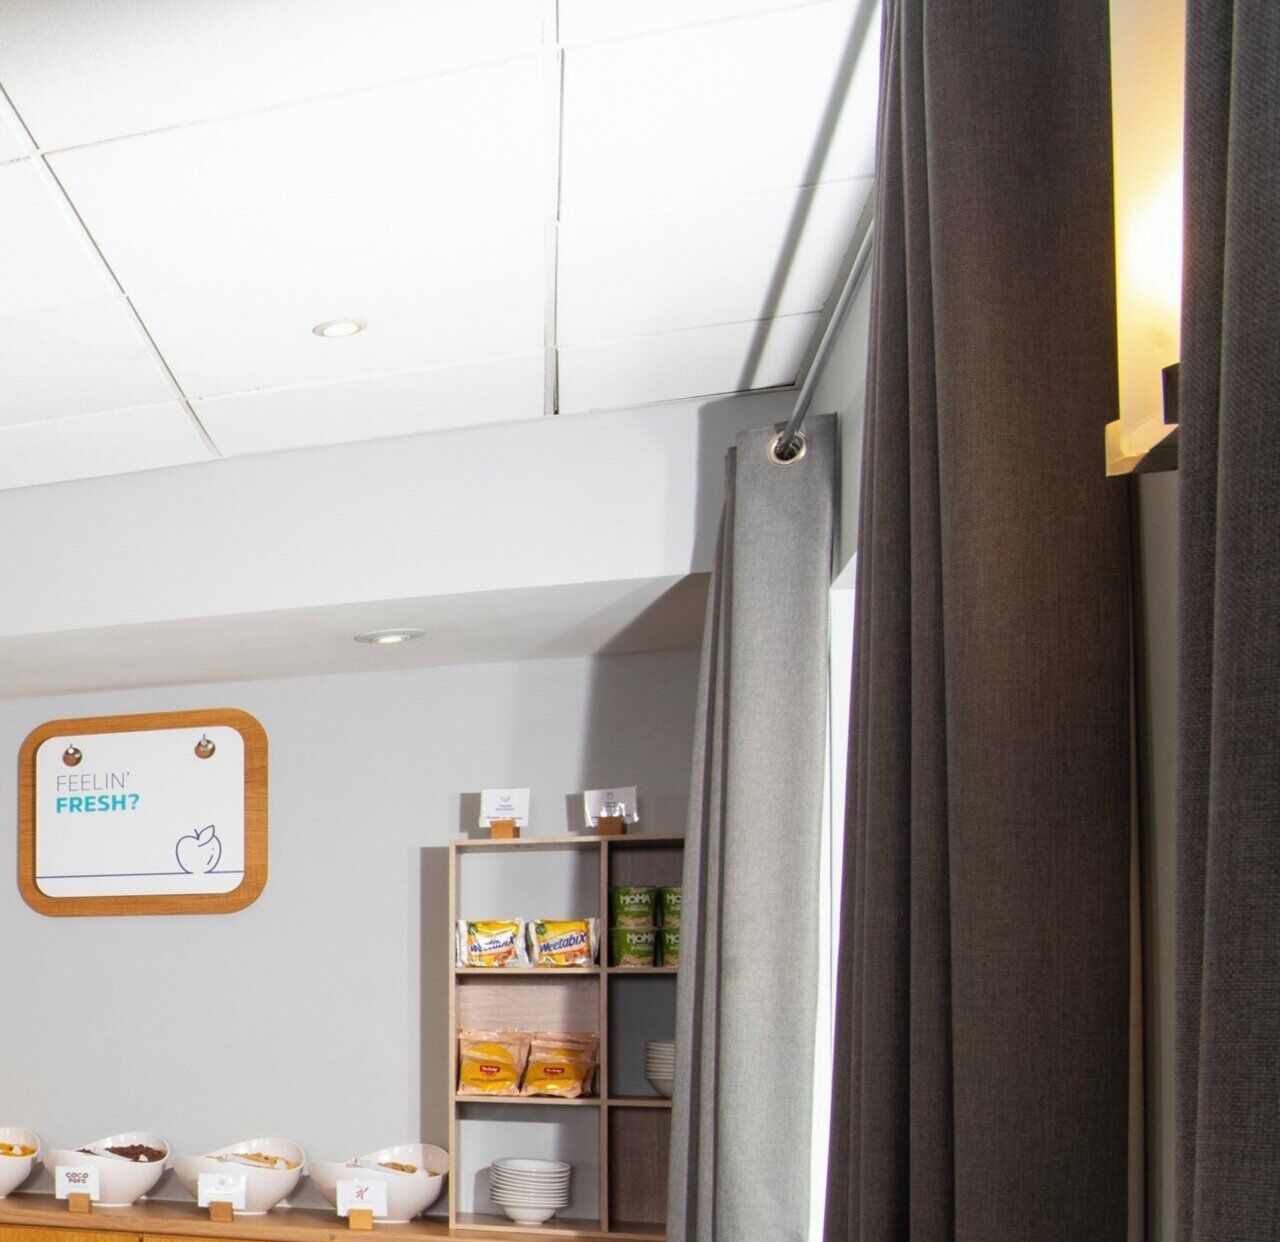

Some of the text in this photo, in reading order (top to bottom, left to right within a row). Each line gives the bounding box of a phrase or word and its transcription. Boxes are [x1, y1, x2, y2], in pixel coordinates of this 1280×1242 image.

[56, 771, 130, 792] FEELIN'
[56, 793, 140, 813] FRESH?
[666, 894, 682, 905] MO
[540, 932, 587, 953] Weetabix
[666, 933, 680, 944] MO
